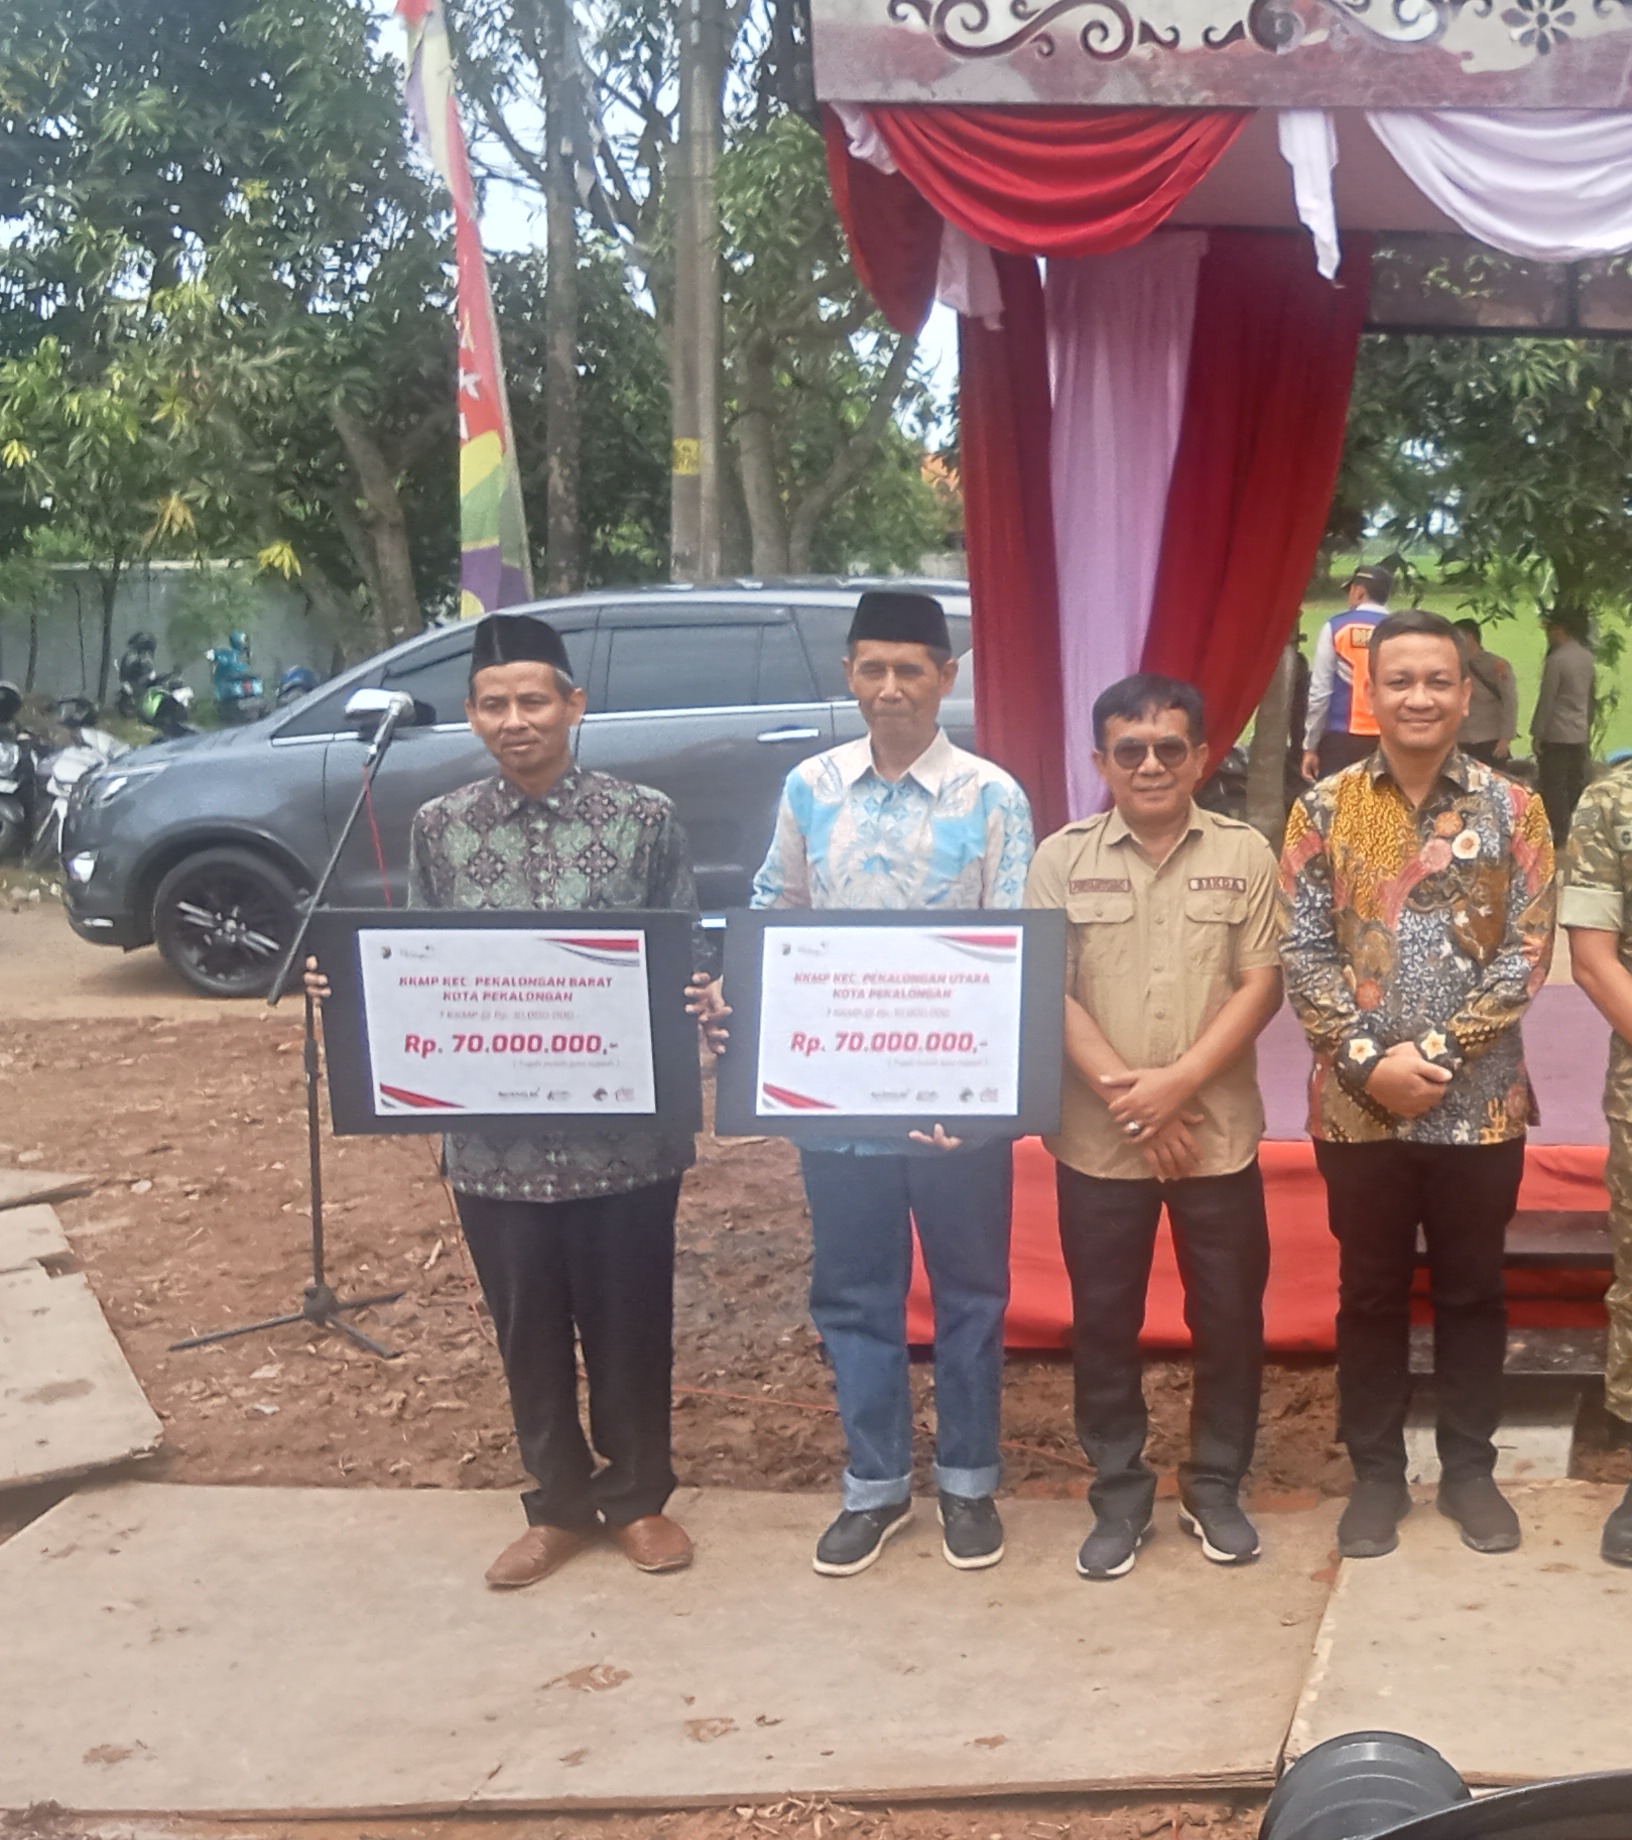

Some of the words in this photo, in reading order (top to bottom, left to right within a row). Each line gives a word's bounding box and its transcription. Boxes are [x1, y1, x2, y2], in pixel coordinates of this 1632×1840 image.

[399, 976, 439, 988] KKMP
[475, 976, 568, 988] PEKALONGAN
[569, 976, 613, 988] BARAT
[794, 973, 830, 984] KKMP
[862, 972, 947, 985] PEKALONGAN
[949, 972, 990, 984] UTARA
[443, 991, 479, 1002] KOTA
[483, 991, 573, 1002] PEKALONGAN
[833, 988, 866, 1000] KOTA
[868, 988, 952, 1000] PEKALONGAN
[404, 1033, 443, 1059] Rp.
[452, 1033, 619, 1055] 70.000.000,-
[790, 1031, 826, 1058] Rp.
[835, 1031, 989, 1054] 70.000.000,-
